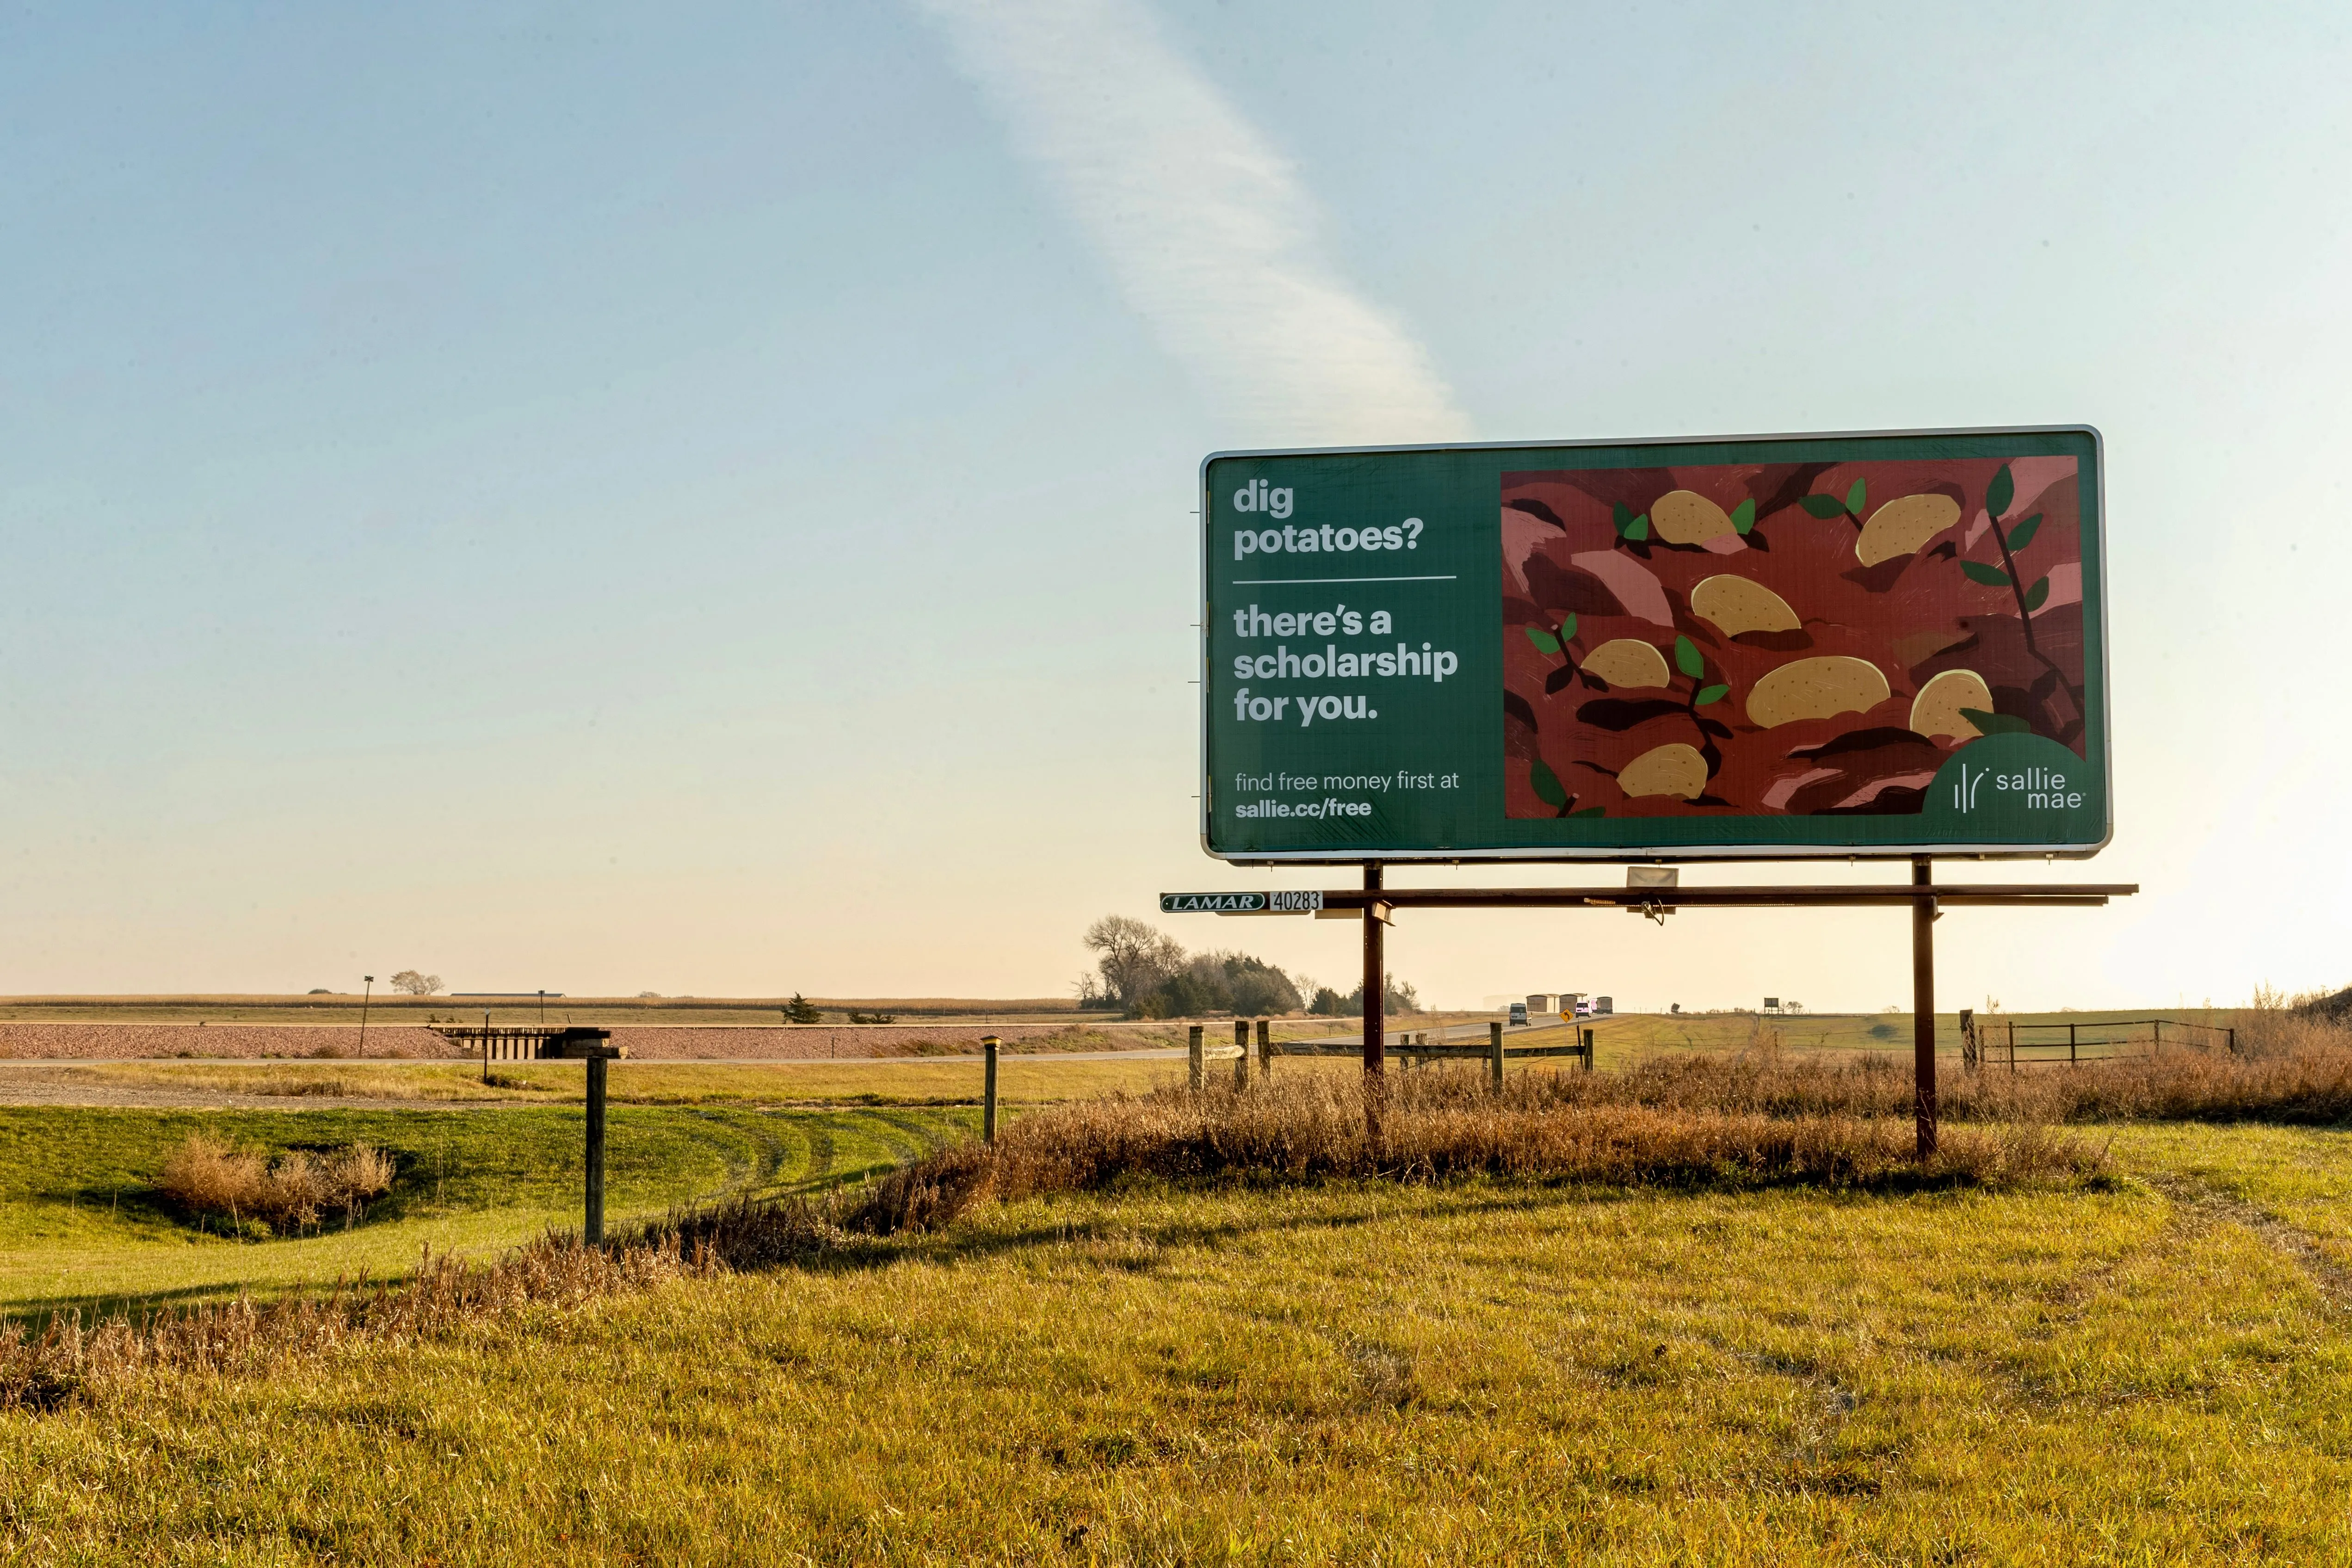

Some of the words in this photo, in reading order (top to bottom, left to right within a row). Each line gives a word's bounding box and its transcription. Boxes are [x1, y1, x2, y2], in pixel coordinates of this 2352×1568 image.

[1234, 479, 1293, 519] dig
[1234, 518, 1423, 560] potatoes?
[1233, 604, 1362, 637] there's
[1370, 611, 1391, 635] a
[1234, 642, 1457, 682] scholarship
[1234, 688, 1289, 721] for
[1296, 695, 1377, 727] you.
[1235, 773, 1272, 790] find
[1278, 772, 1317, 790] free
[1324, 776, 1391, 792] money
[1397, 771, 1434, 788] first
[1440, 773, 1459, 788] at
[1996, 767, 2065, 790] sallie
[1235, 798, 1371, 819] sallie.cc/free
[1172, 896, 1253, 909] LAMAR
[1273, 891, 1320, 910] 40283
